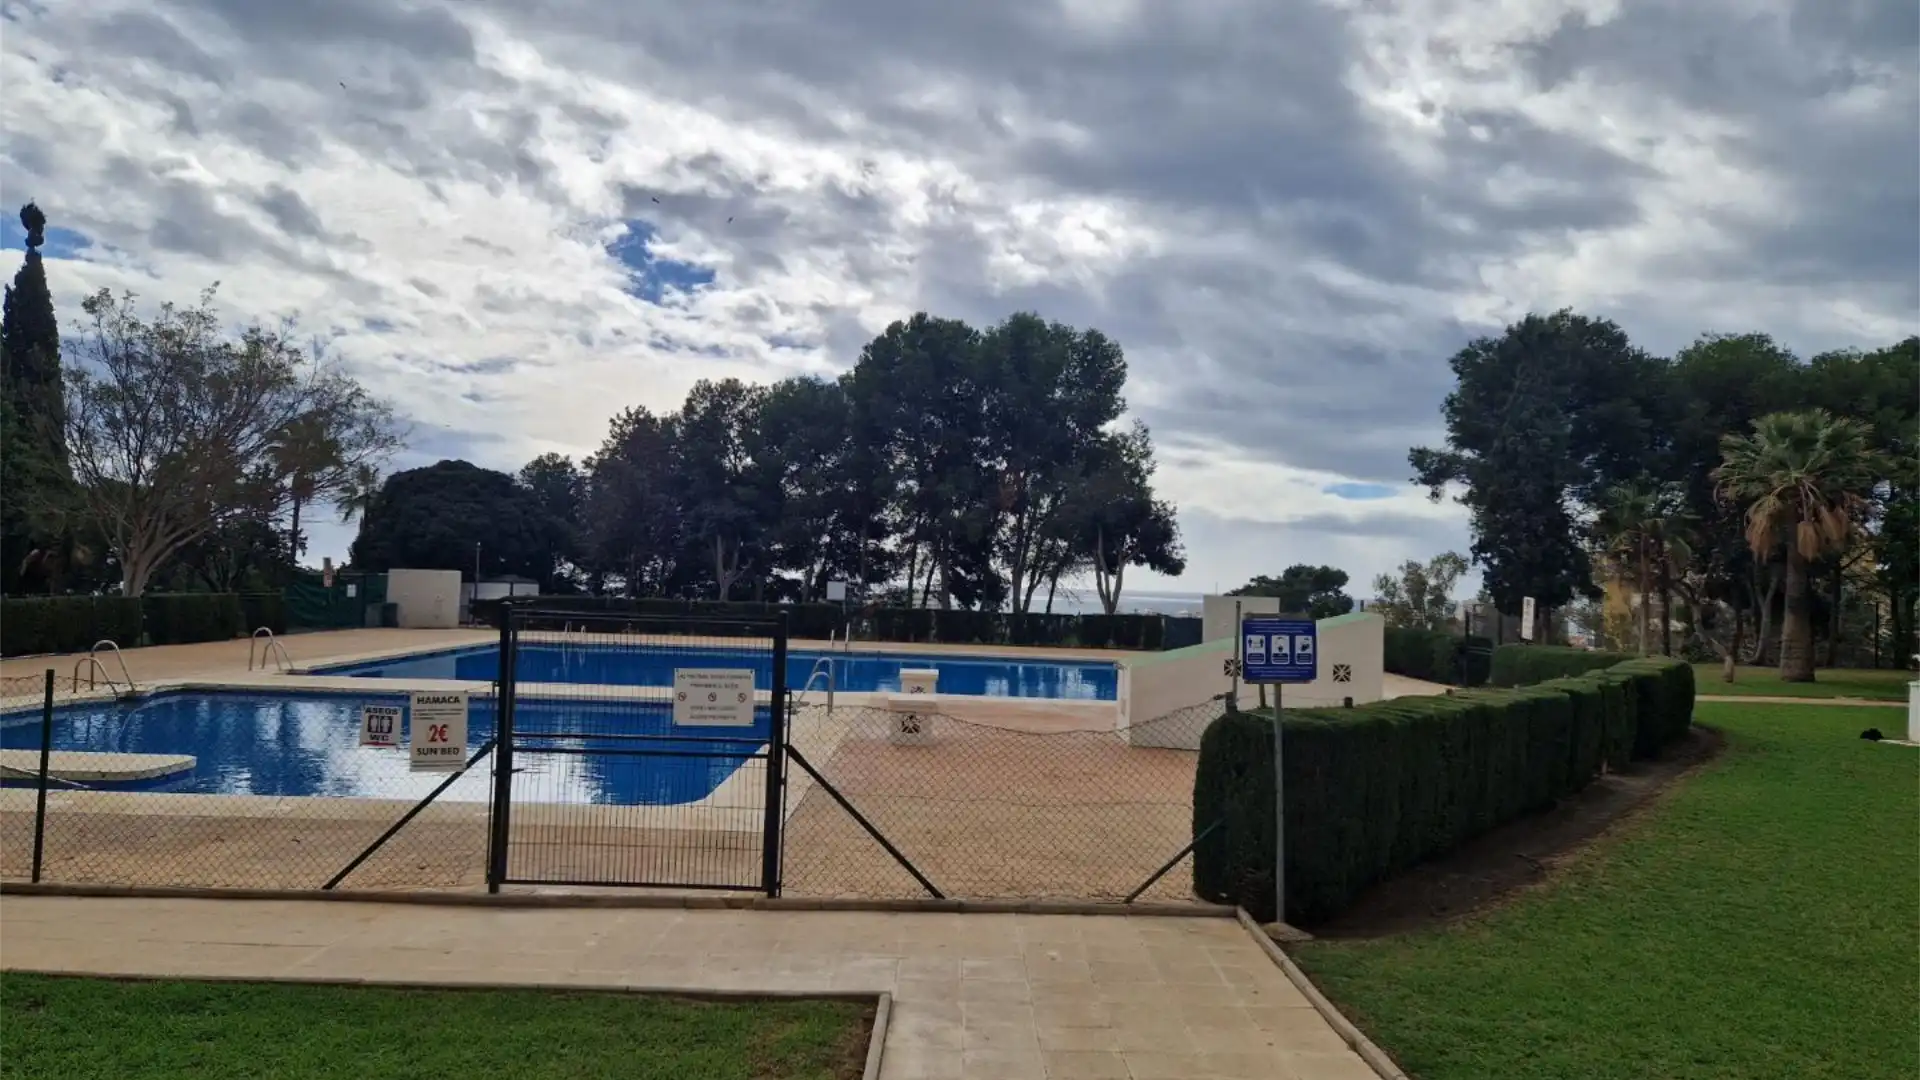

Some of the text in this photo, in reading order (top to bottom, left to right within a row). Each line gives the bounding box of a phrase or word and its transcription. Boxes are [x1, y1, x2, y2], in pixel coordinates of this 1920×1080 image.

[417, 696, 460, 704] HAMACA
[428, 724, 449, 742] 2€
[417, 748, 438, 756] SUN
